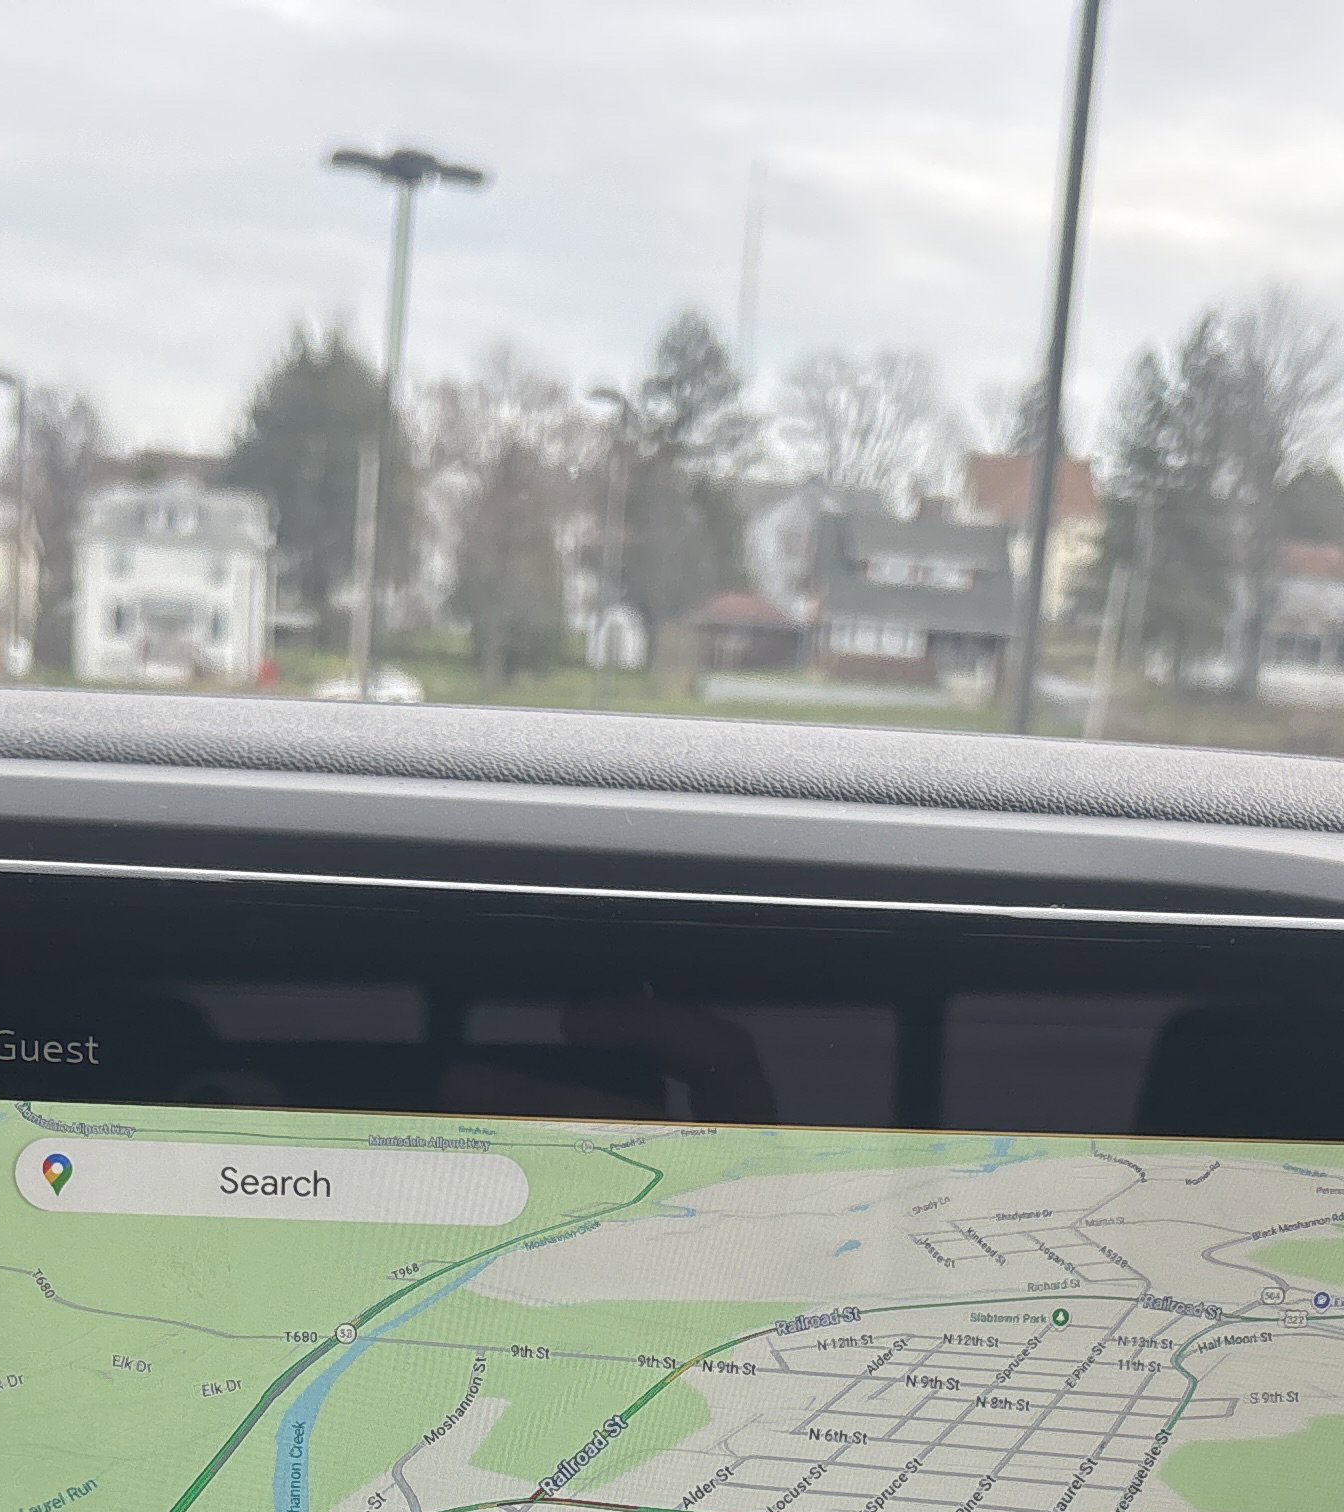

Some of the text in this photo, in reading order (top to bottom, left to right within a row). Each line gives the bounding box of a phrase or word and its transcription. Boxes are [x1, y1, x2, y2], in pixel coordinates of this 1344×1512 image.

[219, 1166, 332, 1199] Search
[391, 1262, 420, 1280] T968
[32, 1267, 56, 1301] T680
[1141, 1294, 1223, 1322] Railroad St
[775, 1305, 862, 1337] Railroad St
[285, 1330, 319, 1344] T680
[816, 1334, 874, 1352] N 12th St
[942, 1334, 1000, 1349] N 12th St
[1117, 1336, 1128, 1348] N
[1158, 1339, 1174, 1352] St
[1197, 1331, 1273, 1354] Half Moon St
[510, 1344, 551, 1360] 9th St
[637, 1354, 676, 1370] 9th St
[866, 1337, 909, 1377] Alder St
[995, 1334, 1042, 1385] Spruce St
[1072, 1356, 1096, 1382] Pine
[1090, 1341, 1107, 1360] St
[111, 1354, 153, 1374] Elk Dr
[701, 1359, 757, 1377] N 9th St
[1118, 1358, 1162, 1374] 11th St
[6, 1373, 24, 1388] Dr
[201, 1378, 243, 1398] Elk Dr
[905, 1374, 961, 1391] N 9th St
[423, 1356, 488, 1447] Moshannon St
[975, 1397, 988, 1409] N
[1015, 1400, 1030, 1412] St
[1248, 1391, 1300, 1405] S 9th St
[291, 1420, 306, 1459] Creek
[808, 1428, 868, 1446] N 6th St
[1154, 1428, 1172, 1448] St
[540, 1414, 628, 1496] Railroad St
[808, 1462, 828, 1481] St
[903, 1456, 924, 1478] St
[1081, 1457, 1100, 1478] St
[66, 1477, 99, 1502] Run
[681, 1465, 735, 1511] Alder St
[979, 1474, 998, 1494] St
